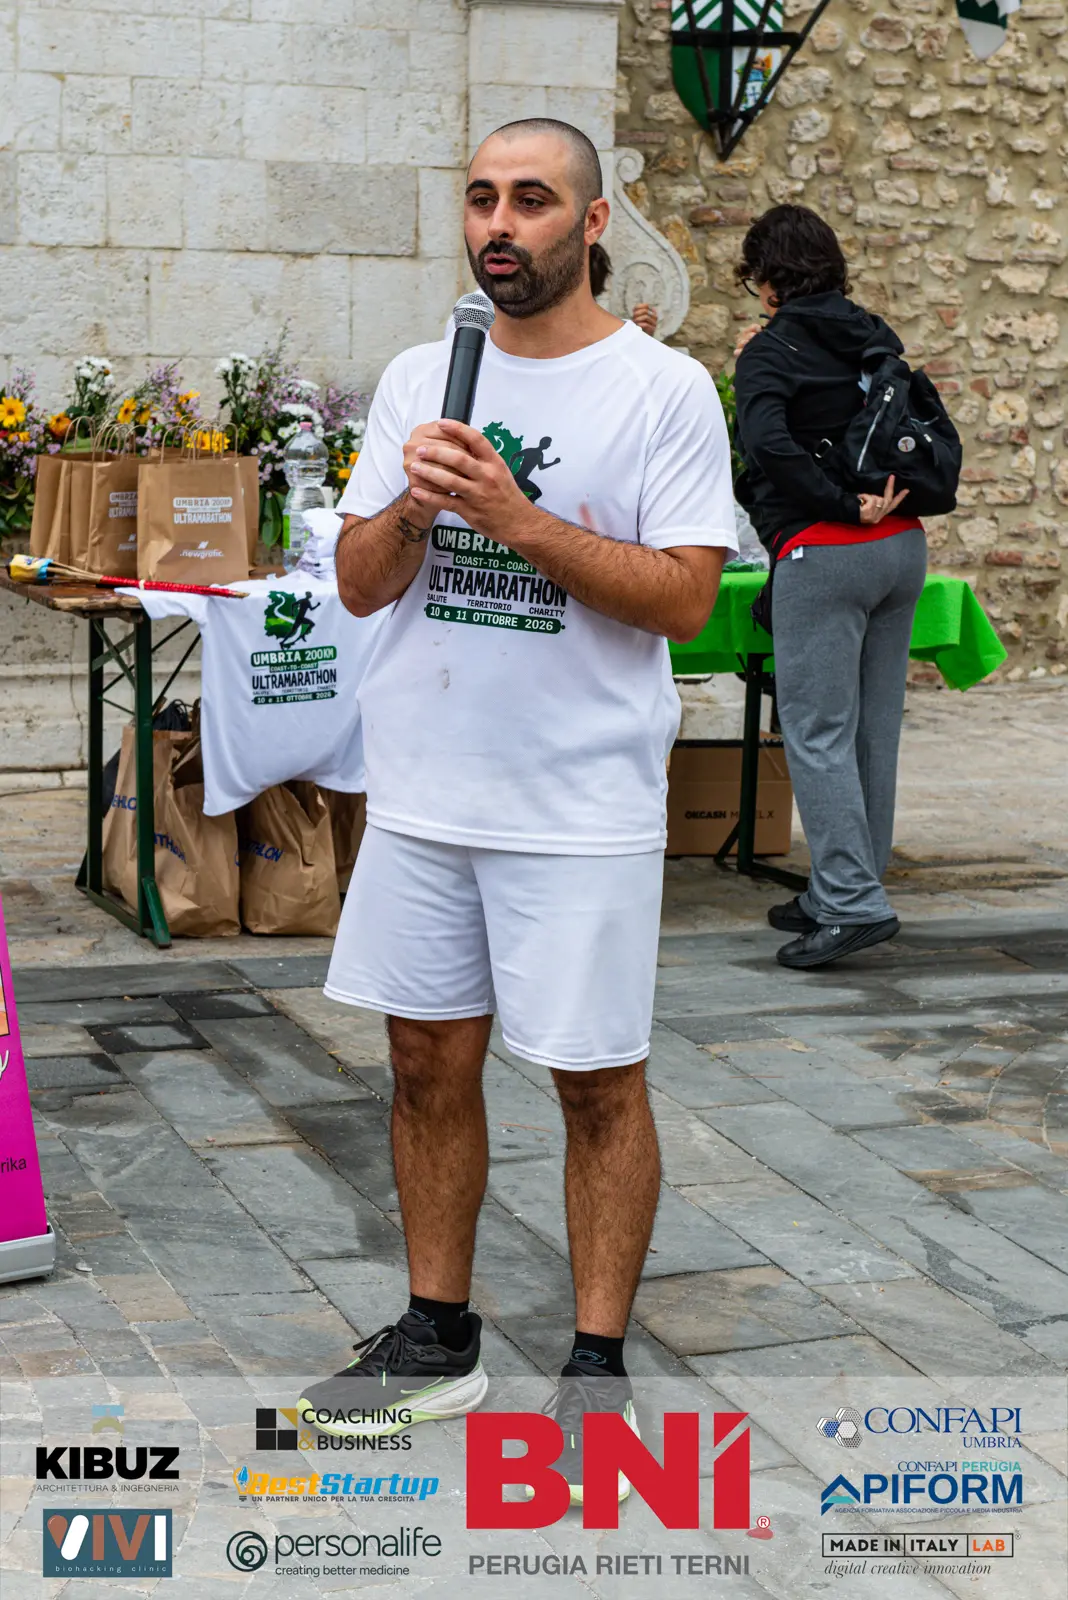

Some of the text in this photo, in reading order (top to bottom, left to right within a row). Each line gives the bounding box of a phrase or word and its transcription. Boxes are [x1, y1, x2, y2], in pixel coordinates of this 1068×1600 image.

[174, 512, 232, 524] ULTRAMARATHON
[428, 565, 568, 607] ULTRAMARATHON
[427, 594, 447, 603] SALUTE
[467, 599, 512, 611] TERRITORIO
[430, 606, 553, 631] 10 e 11 OTTOBRE 2026
[529, 607, 565, 618] CHARITY
[253, 648, 334, 665] UMBRIA 200KM
[252, 668, 337, 690] ULTRAMARATHON
[316, 691, 332, 699] 2026
[1, 1157, 27, 1173] rika
